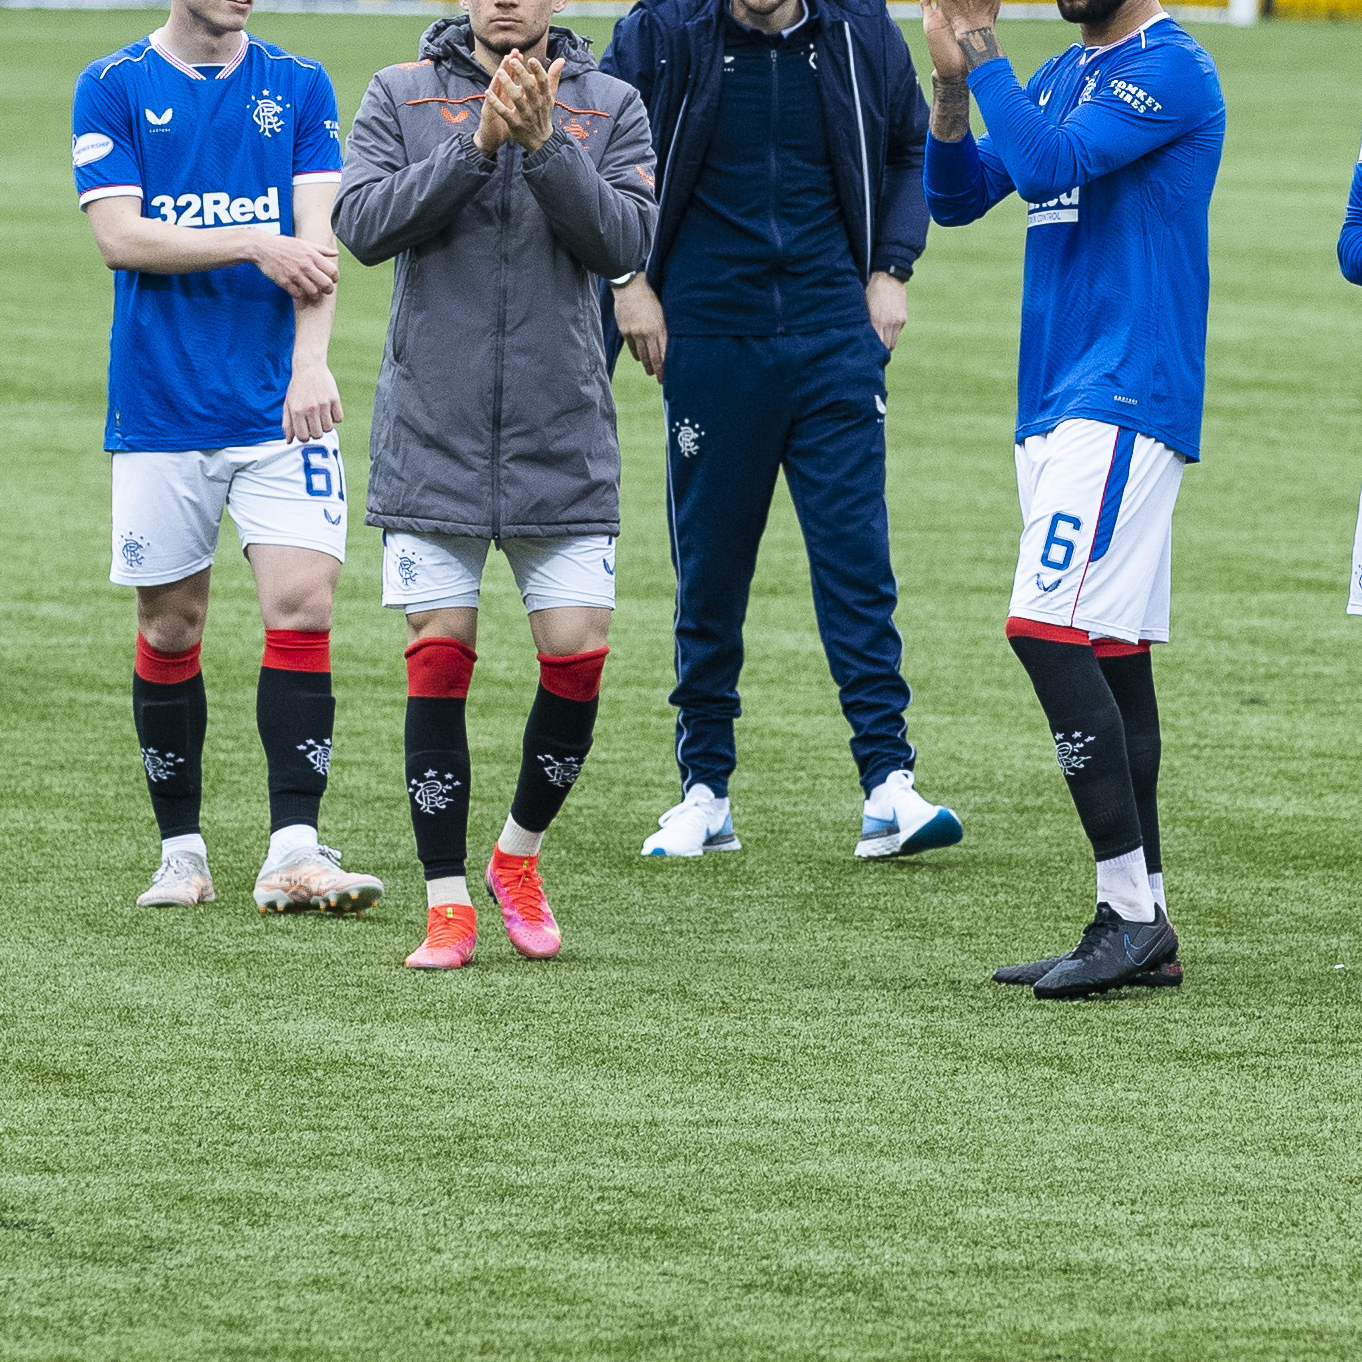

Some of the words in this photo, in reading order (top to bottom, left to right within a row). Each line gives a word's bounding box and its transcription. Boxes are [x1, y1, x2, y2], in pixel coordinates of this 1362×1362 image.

[1110, 79, 1163, 113] TOMKET
[1113, 87, 1147, 114] TIRES
[151, 187, 280, 227] 32Red
[1040, 512, 1081, 571] 6
